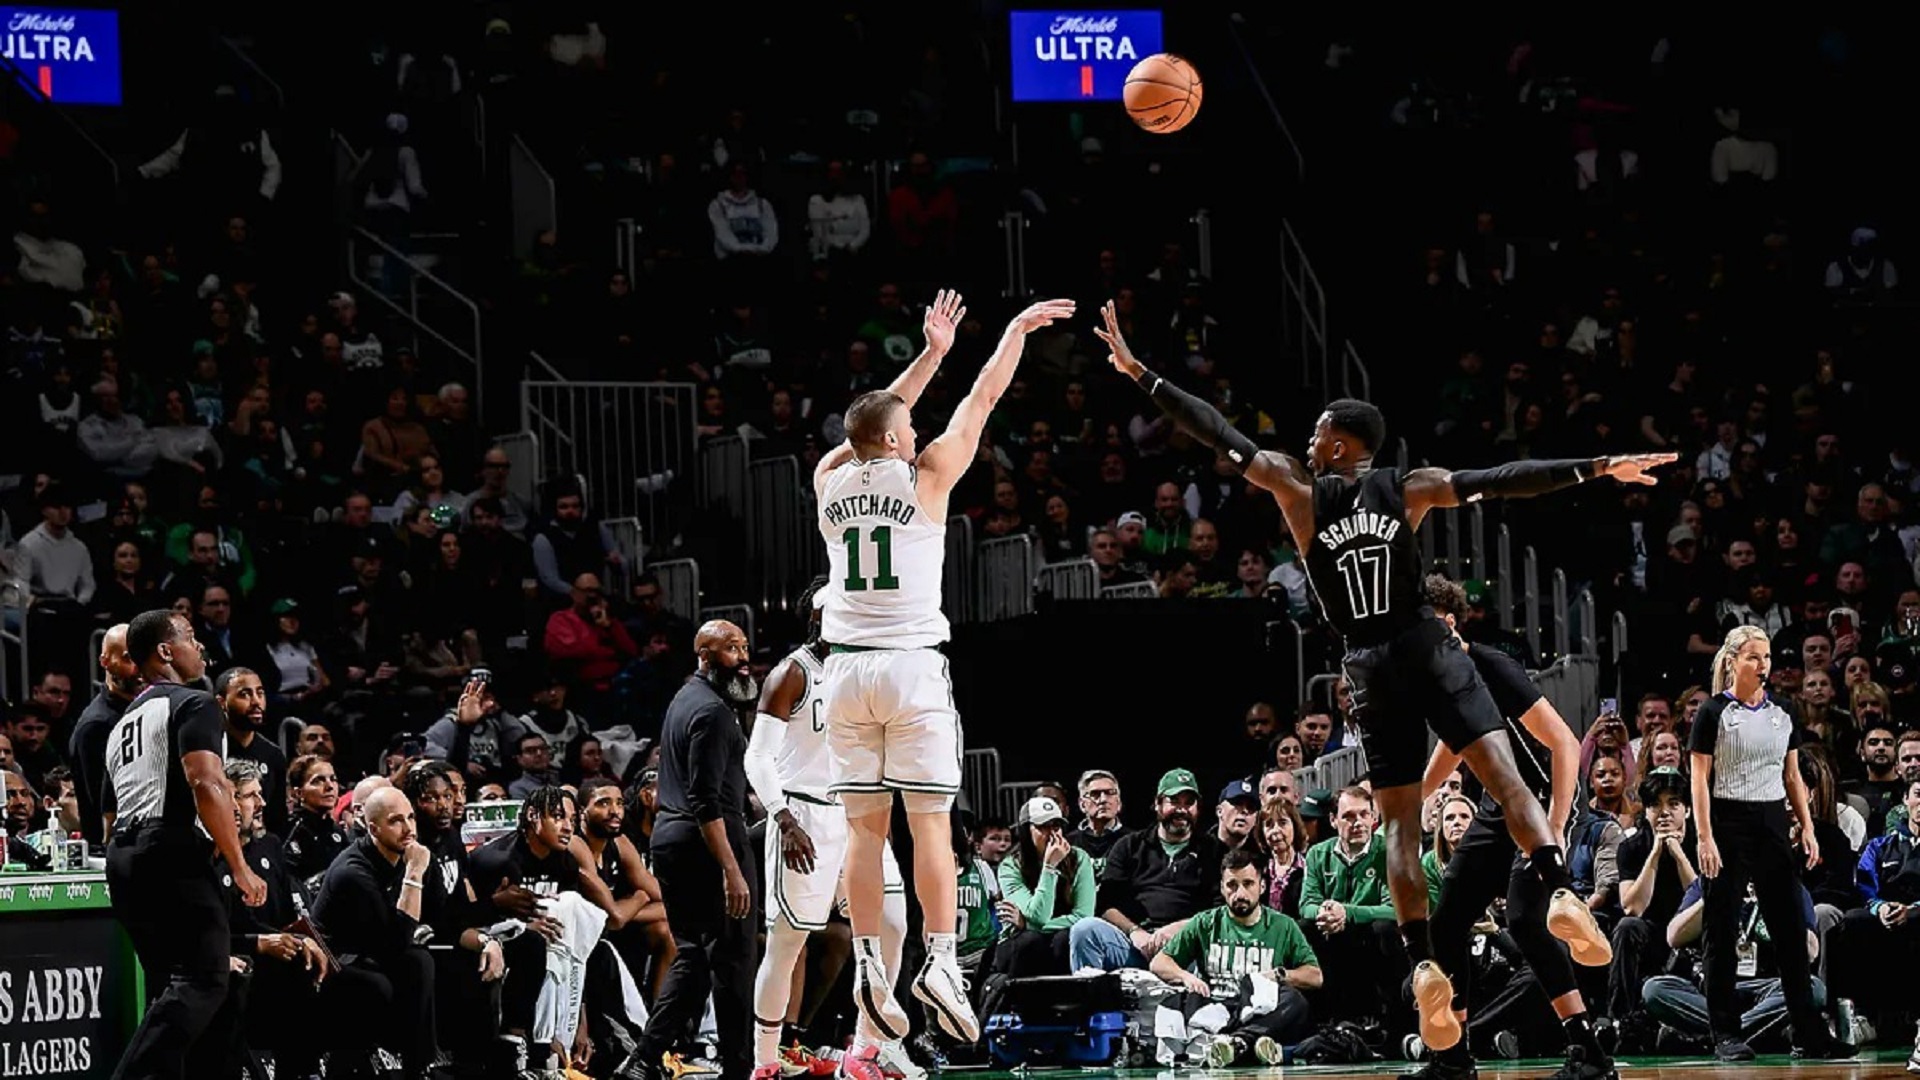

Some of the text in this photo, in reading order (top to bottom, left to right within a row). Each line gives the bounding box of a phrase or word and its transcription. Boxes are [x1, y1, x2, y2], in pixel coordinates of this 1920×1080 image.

[1035, 35, 1138, 61] ULTRA
[824, 493, 915, 527] PRITCHARD
[842, 526, 899, 591] 11
[1335, 543, 1391, 620] 17
[121, 714, 144, 767] 21
[21, 965, 103, 1024] ABBY
[2, 1036, 91, 1078] LAGERS
